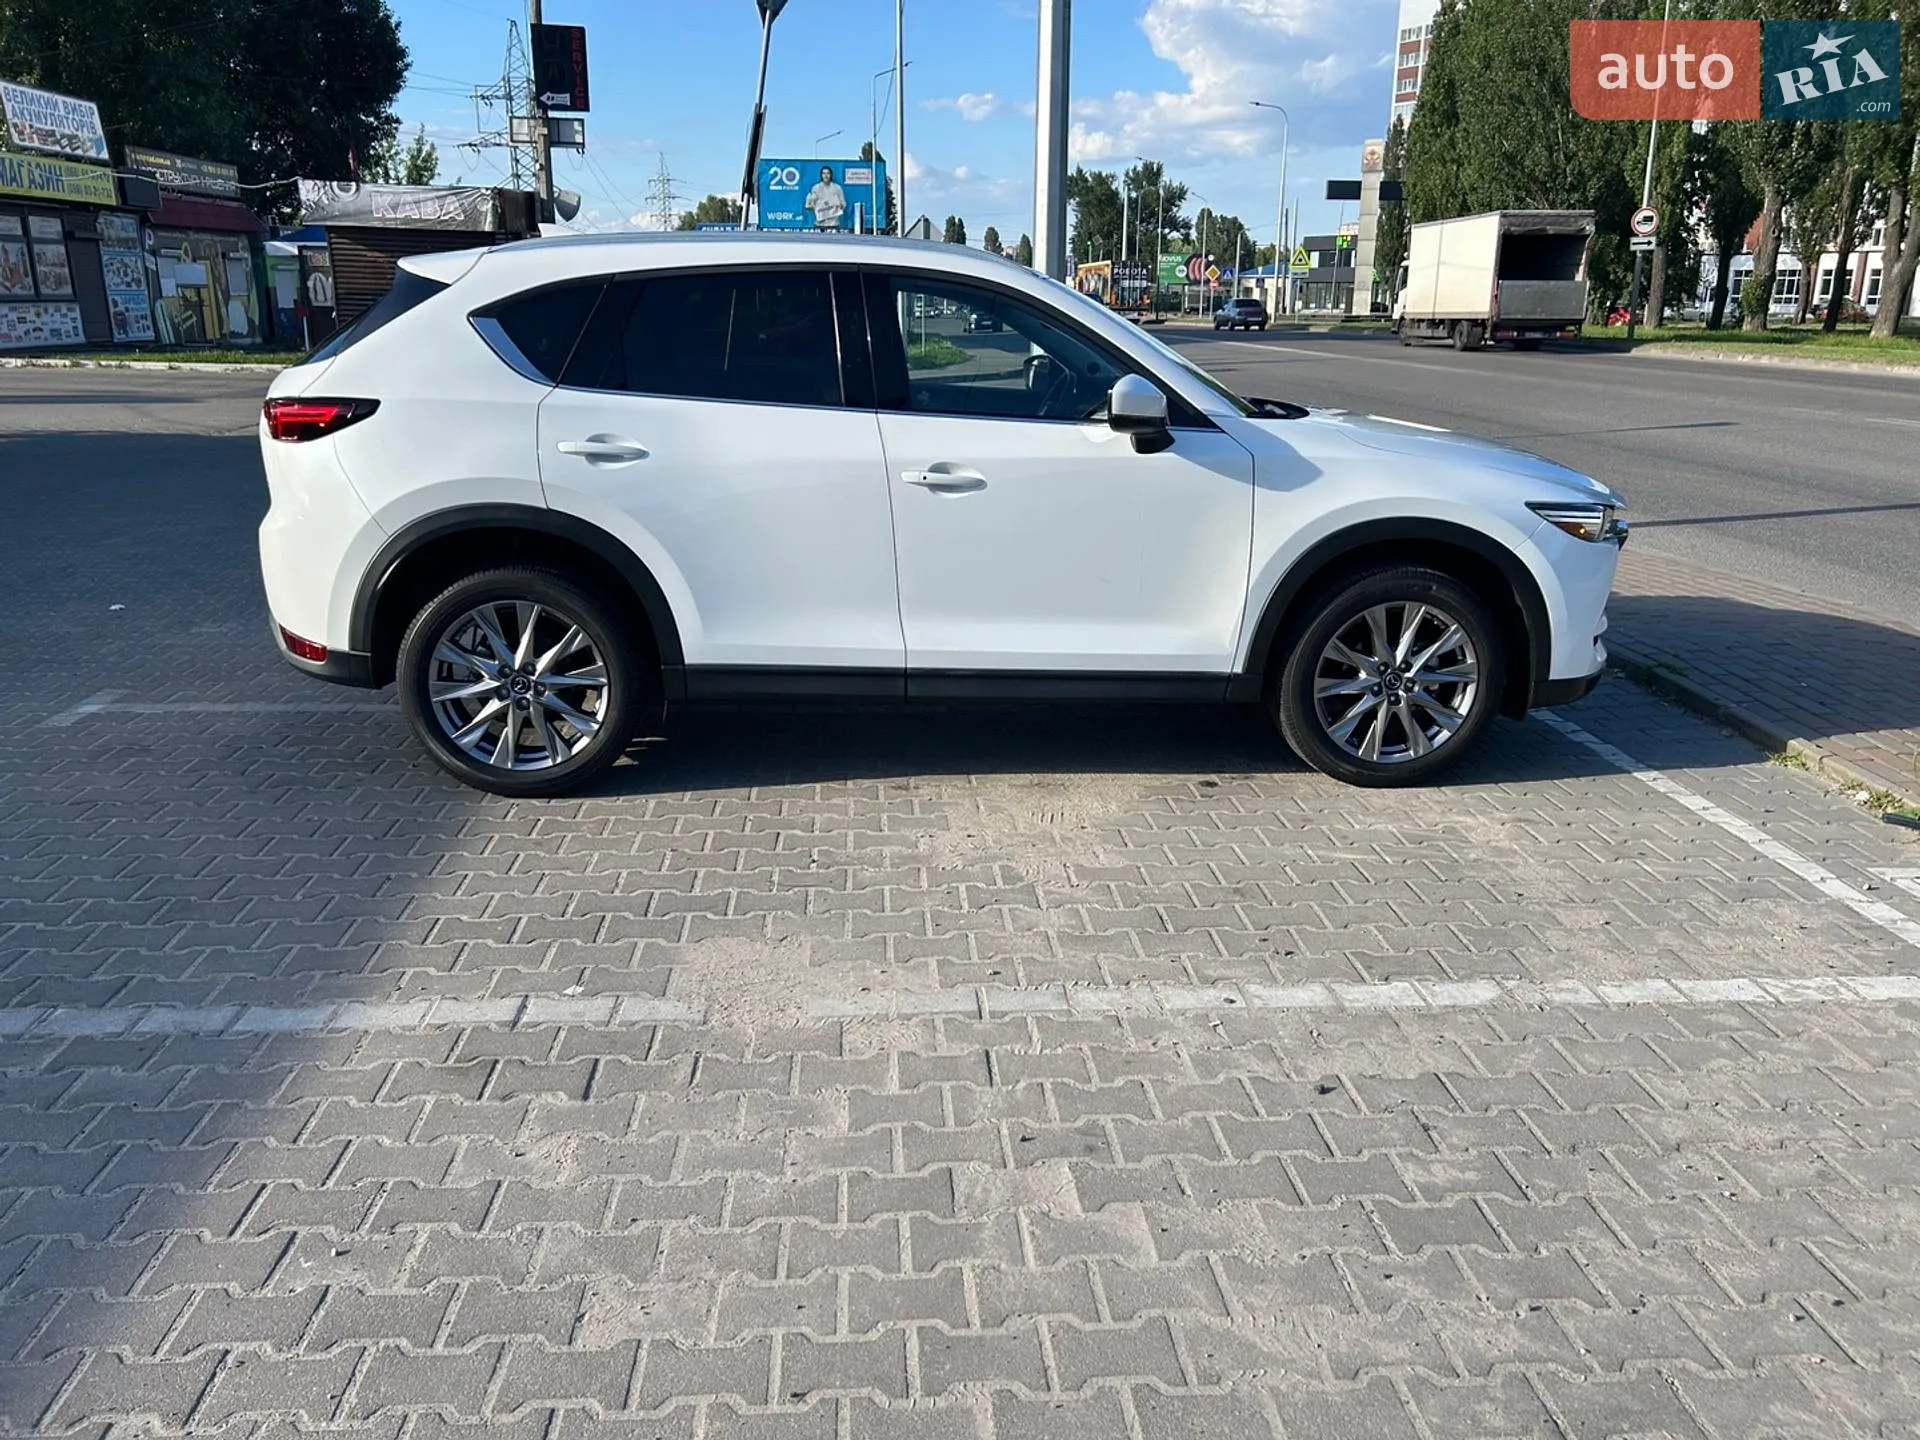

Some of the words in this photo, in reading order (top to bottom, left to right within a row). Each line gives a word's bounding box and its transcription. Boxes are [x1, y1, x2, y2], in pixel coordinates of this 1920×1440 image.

[571, 28, 585, 108] SERVICE
[3, 85, 60, 112] ВЕЛИКИЙ
[62, 100, 96, 120] ВИБІР
[11, 104, 97, 135] АКУМУЛЯТОРІВ
[768, 166, 800, 185] 20
